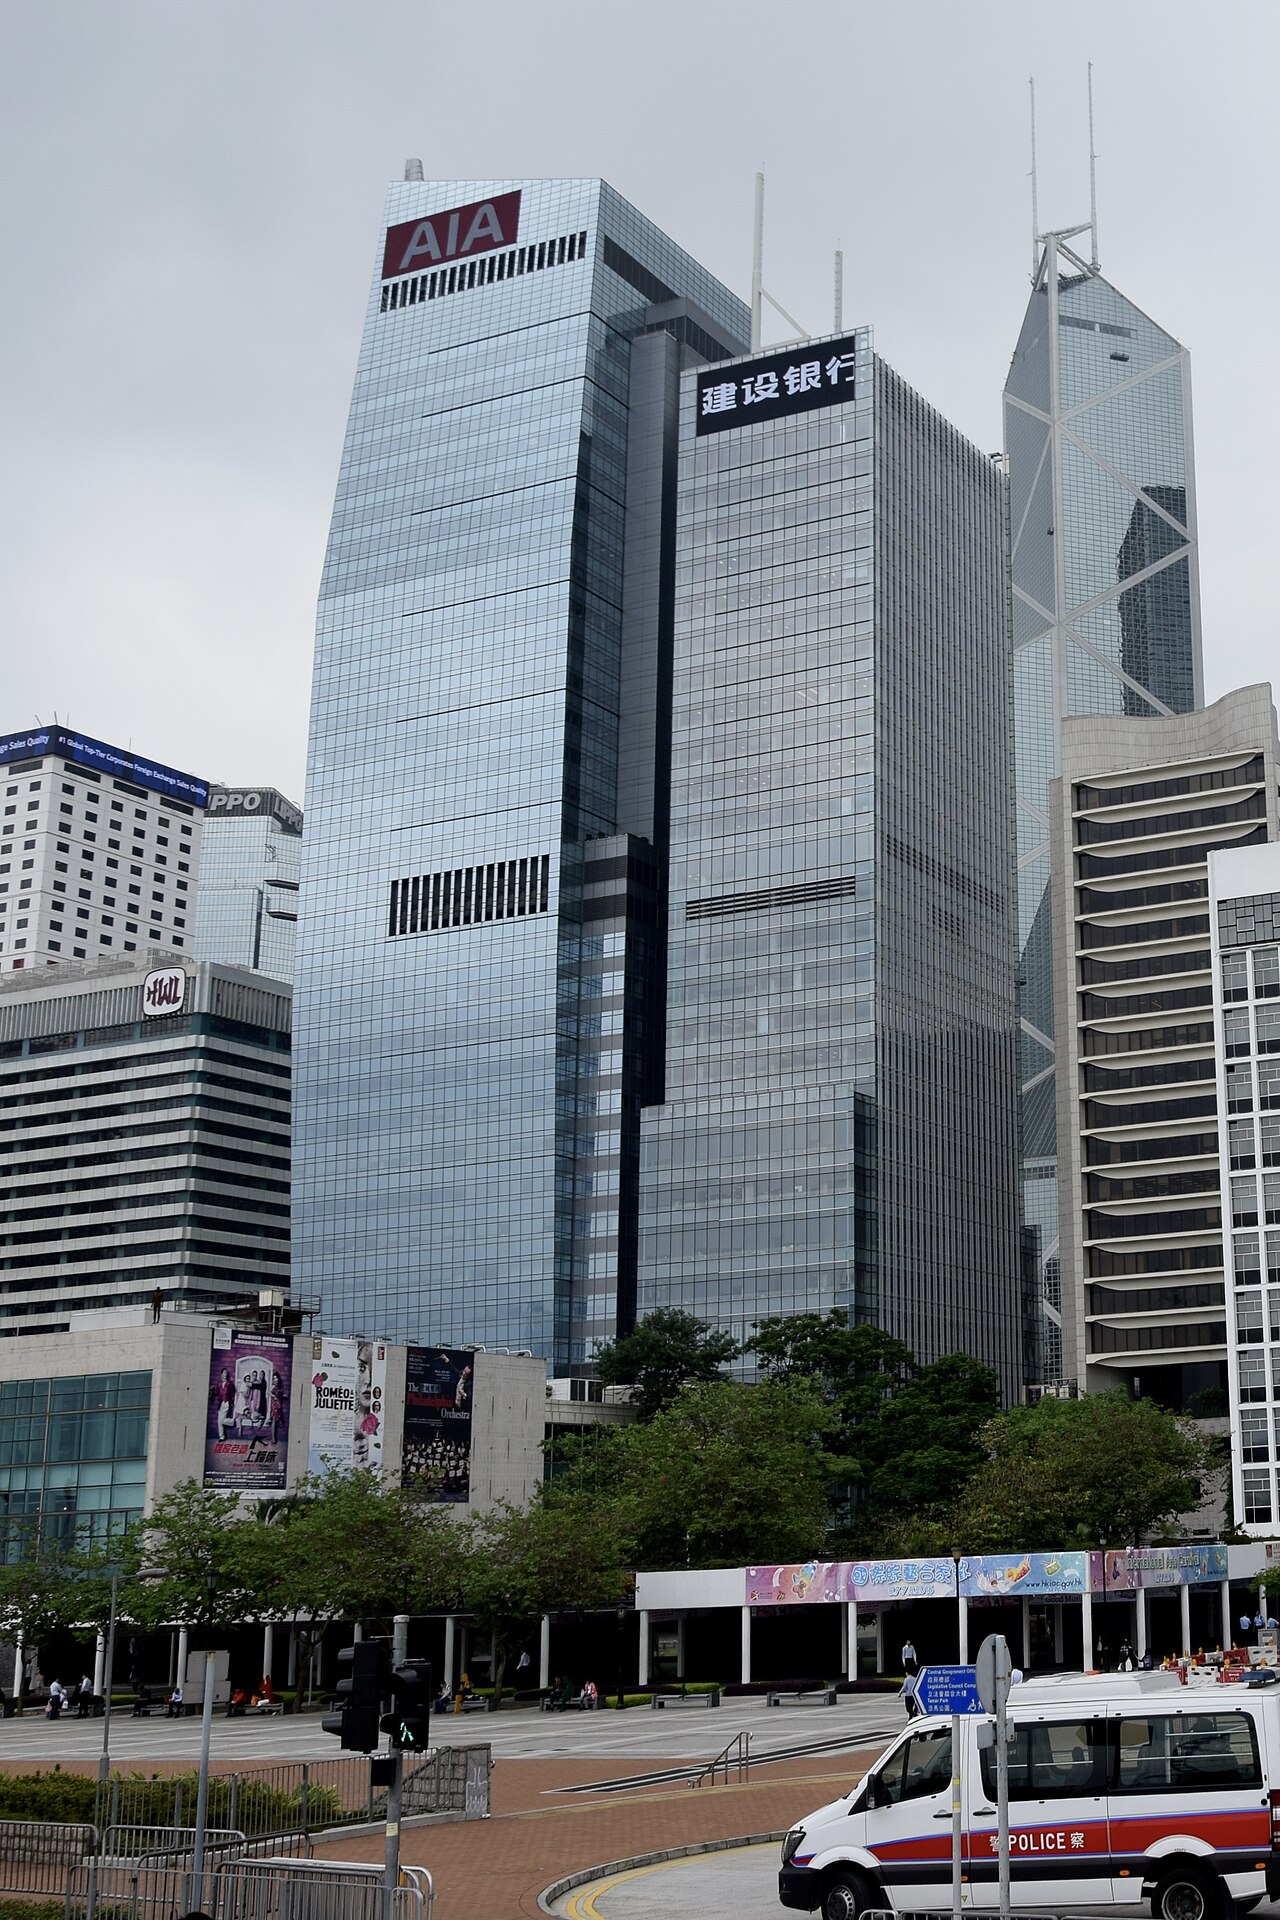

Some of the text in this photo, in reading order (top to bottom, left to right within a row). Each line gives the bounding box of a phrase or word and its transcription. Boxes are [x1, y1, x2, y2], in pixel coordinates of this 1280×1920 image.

[399, 203, 504, 269] AIA
[702, 352, 855, 415] 建设银行
[9, 740, 26, 750] Sales
[27, 735, 50, 747] Quality
[66, 739, 84, 751] Global
[84, 745, 106, 759] Top-Tier
[134, 763, 153, 777] Foreign
[153, 770, 176, 785] Exchange
[176, 779, 190, 790] Sales
[190, 785, 207, 798] Quality
[274, 796, 303, 832] LIPPO
[316, 1386, 350, 1399] ROMÉO
[408, 1382, 420, 1392] The
[314, 1397, 354, 1411] JULIETTE
[441, 1407, 470, 1419] Orchestra
[1008, 1832, 1067, 1851] POLICE
[1070, 1832, 1085, 1849] 察
